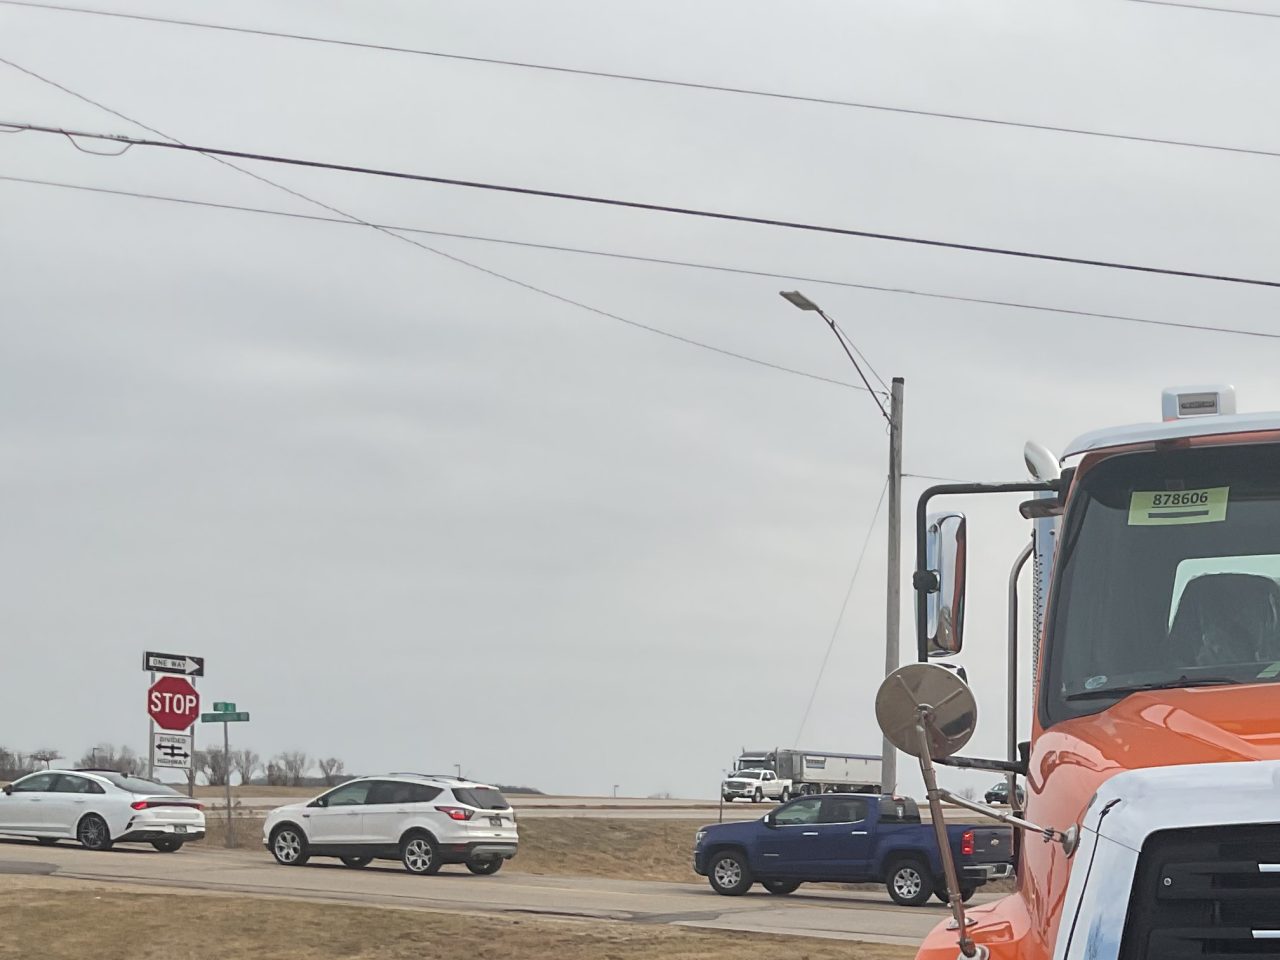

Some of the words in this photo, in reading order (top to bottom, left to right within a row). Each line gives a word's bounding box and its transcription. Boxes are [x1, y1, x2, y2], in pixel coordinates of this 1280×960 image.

[1152, 492, 1209, 506] 878606
[152, 658, 168, 667] ONE
[171, 660, 186, 669] WAY
[150, 691, 197, 715] STOP
[159, 736, 187, 744] DIVIDED
[157, 758, 188, 766] HIGHWAY
